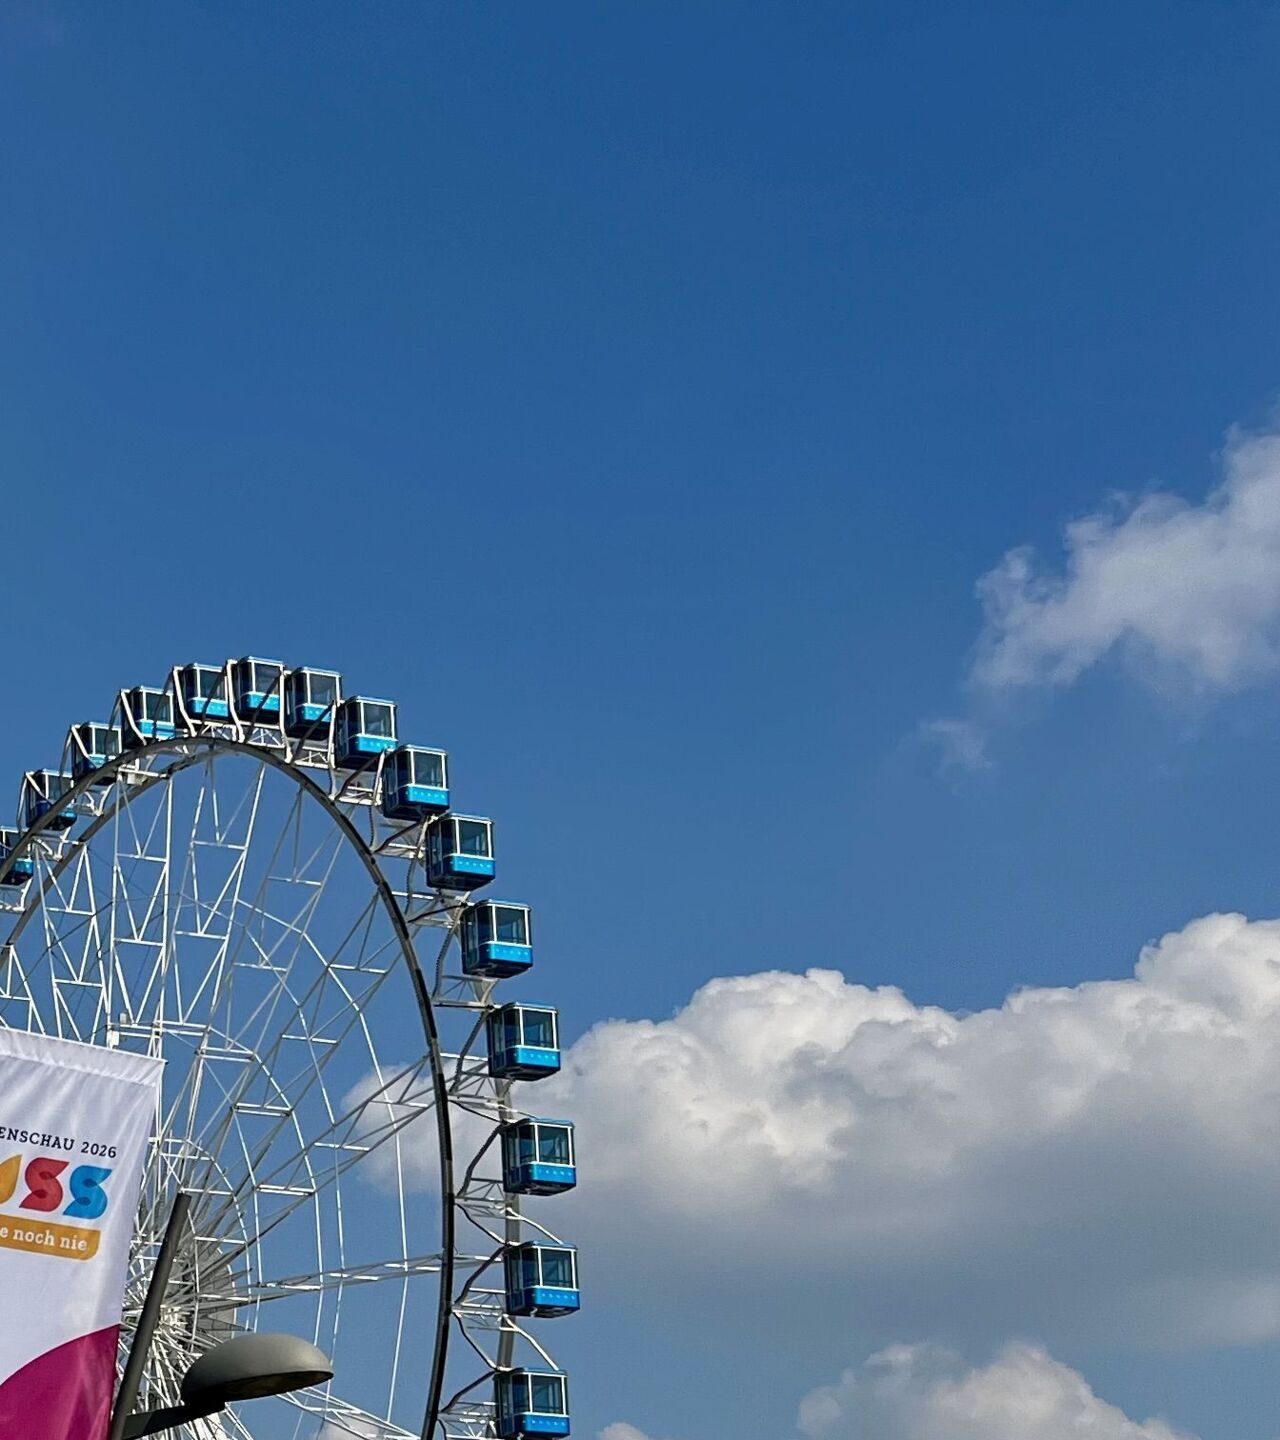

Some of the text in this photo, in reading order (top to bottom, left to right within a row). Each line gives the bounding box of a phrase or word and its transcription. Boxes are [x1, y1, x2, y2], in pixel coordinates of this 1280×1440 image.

[80, 1141, 118, 1159] 2026
[12, 1227, 55, 1249] noch
[59, 1235, 88, 1252] nie
